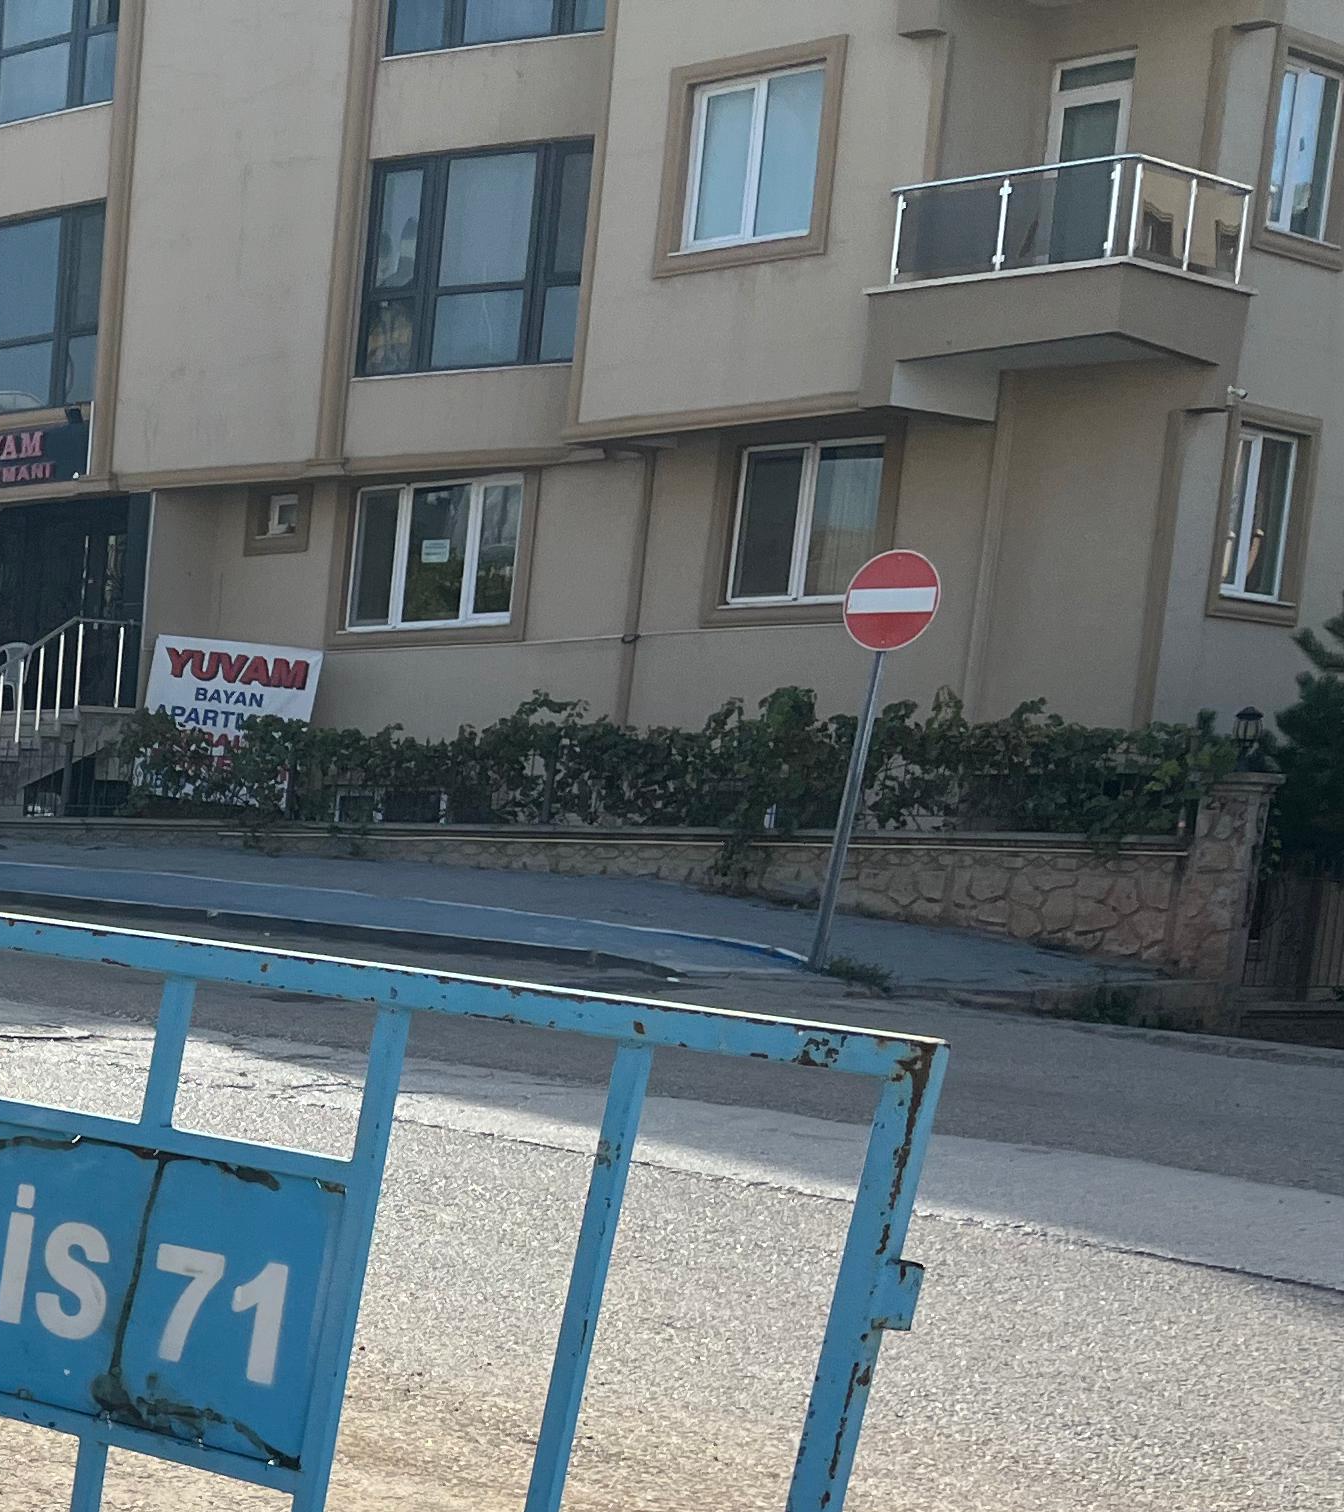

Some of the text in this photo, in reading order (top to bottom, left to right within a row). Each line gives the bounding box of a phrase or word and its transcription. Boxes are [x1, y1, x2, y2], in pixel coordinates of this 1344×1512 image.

[165, 647, 310, 691] YUVAM
[194, 687, 264, 708] BAYAN
[155, 1243, 290, 1386] 71
